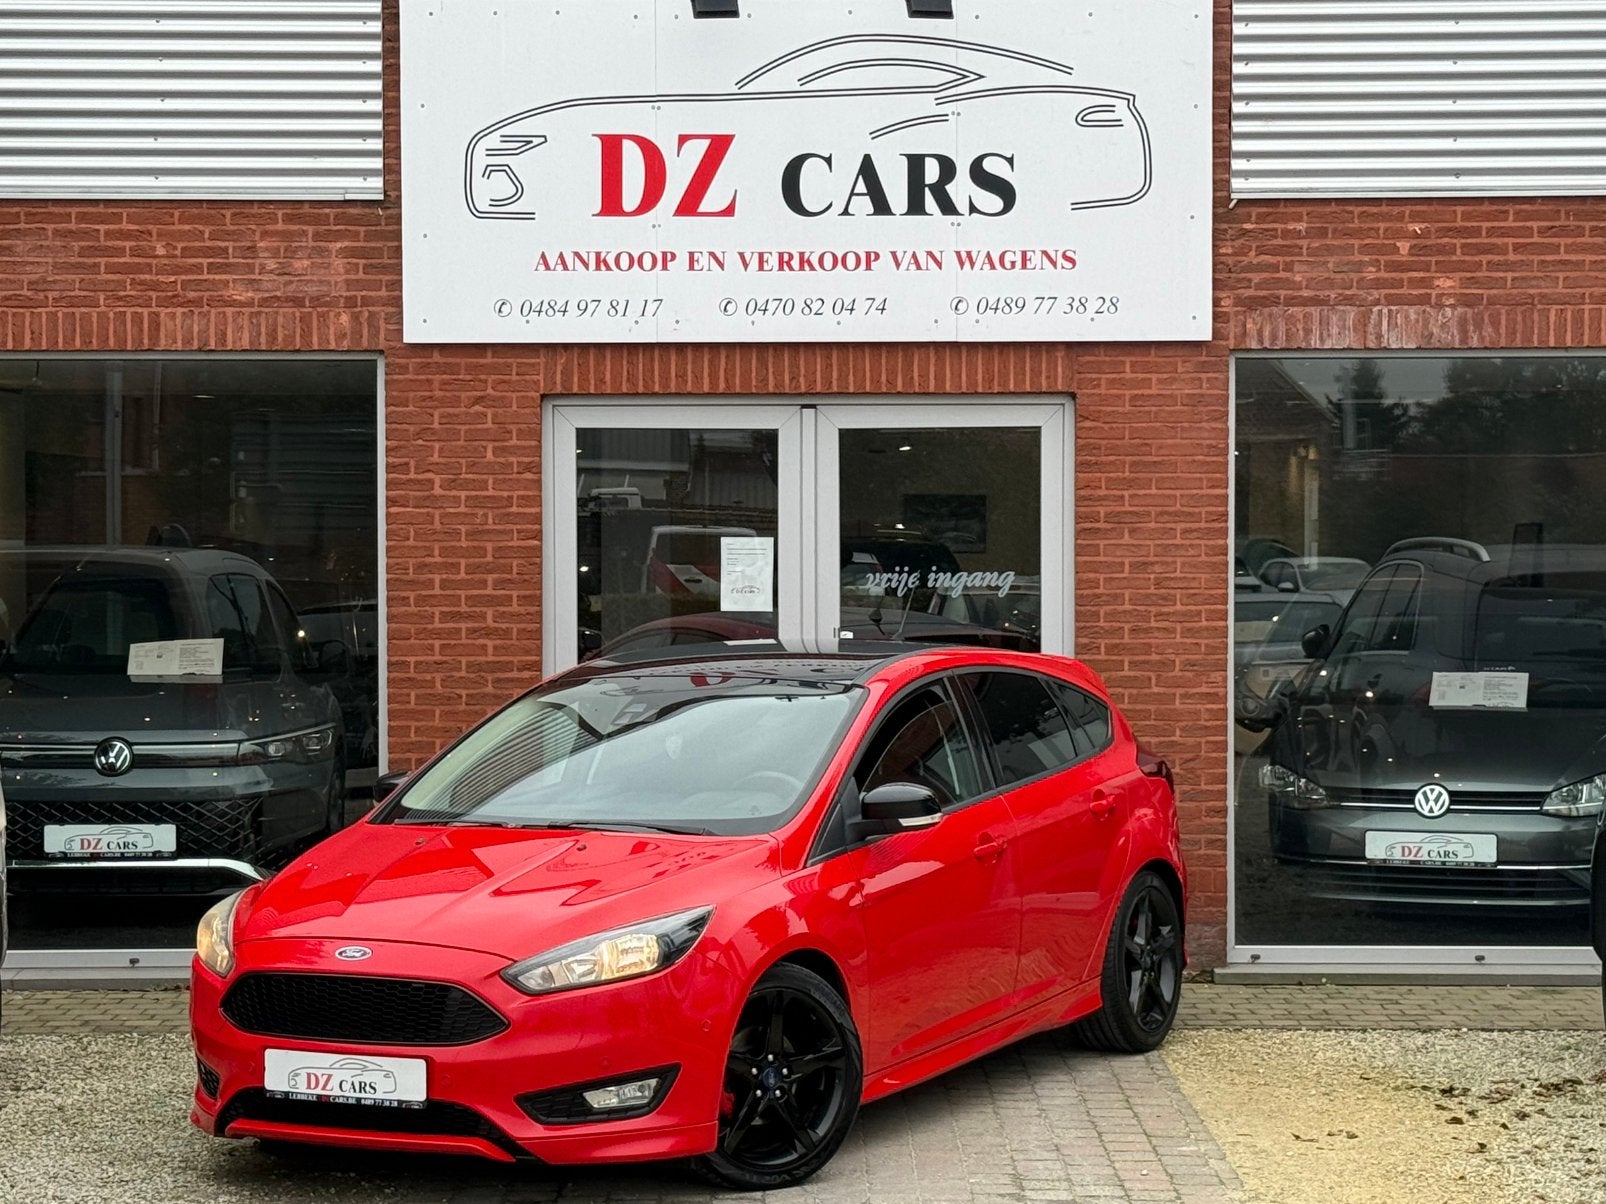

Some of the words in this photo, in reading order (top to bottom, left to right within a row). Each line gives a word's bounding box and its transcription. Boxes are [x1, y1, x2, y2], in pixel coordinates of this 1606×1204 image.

[591, 133, 737, 217] DZ
[781, 152, 1017, 217] CARS
[534, 250, 677, 272] AANKOOP
[687, 250, 726, 272] EN
[737, 250, 881, 272] VERKOOP
[889, 250, 944, 271] VAN
[953, 249, 1077, 271] WAGENS
[519, 298, 569, 317] 0484
[576, 298, 601, 317] 97
[607, 298, 631, 317] 81
[638, 298, 664, 317] 17
[745, 297, 795, 316] 0470
[801, 297, 825, 316] 82
[831, 297, 857, 316] 04
[863, 297, 888, 316] 74
[976, 296, 1026, 316] 0489
[1033, 296, 1058, 315] 77
[1063, 296, 1088, 315] 38
[1094, 296, 1119, 315] 28
[865, 566, 921, 598] vrije
[927, 565, 1016, 598] ingang
[79, 837, 103, 851] DZ
[107, 840, 138, 851] CARS
[1400, 845, 1423, 859] DZ
[1427, 849, 1459, 859] CARS
[305, 1072, 334, 1091] DZ
[338, 1079, 378, 1095] CARS
